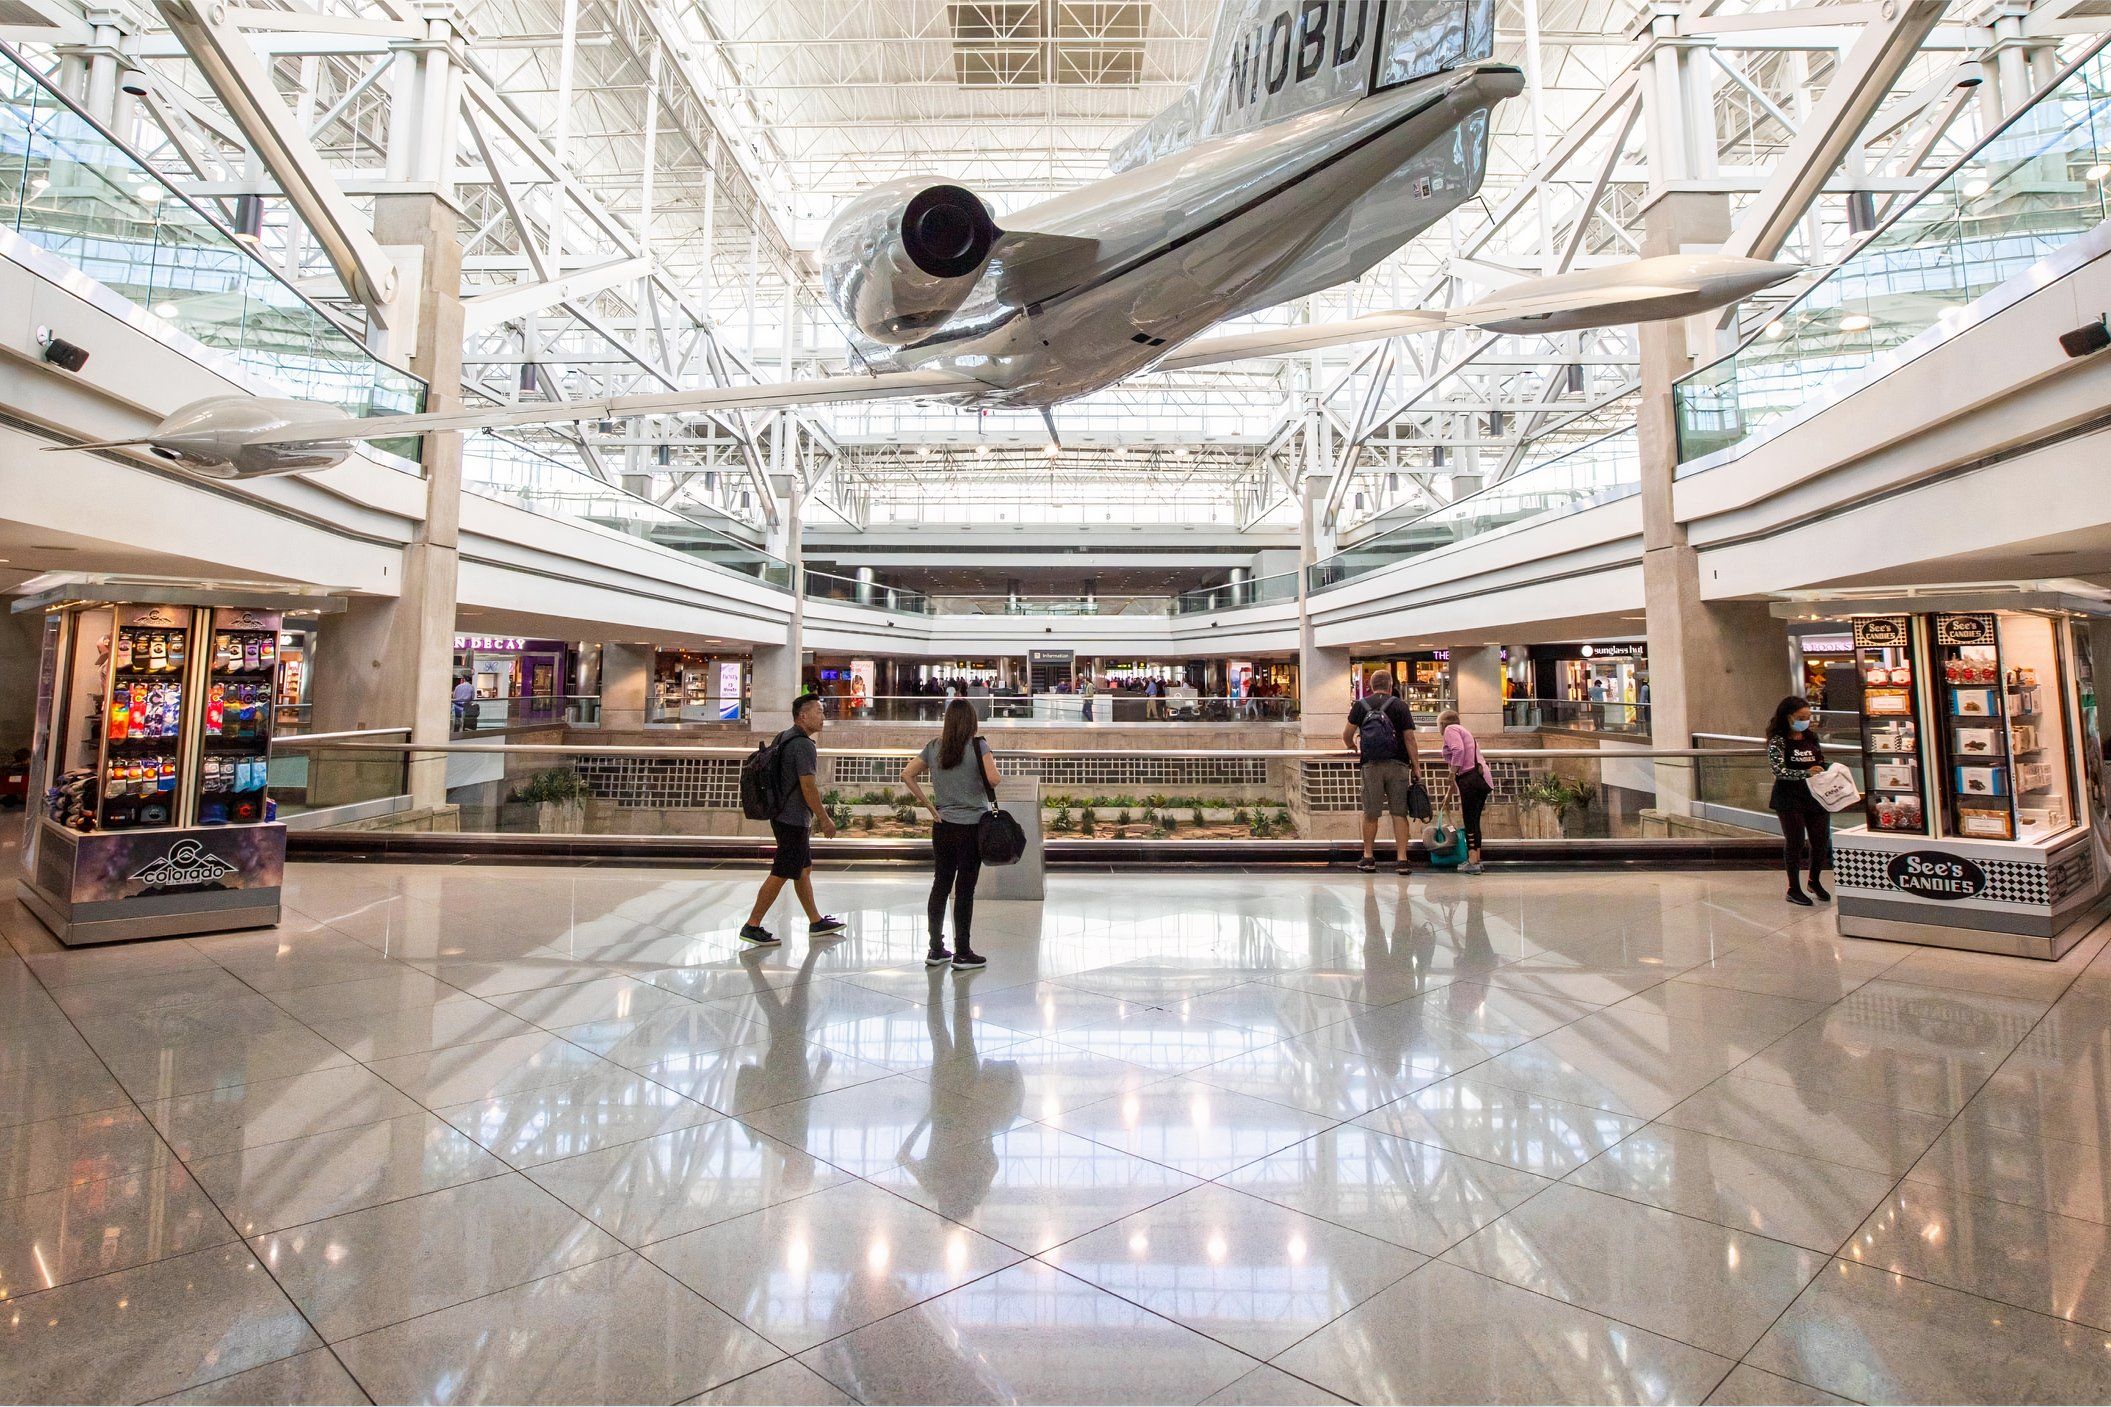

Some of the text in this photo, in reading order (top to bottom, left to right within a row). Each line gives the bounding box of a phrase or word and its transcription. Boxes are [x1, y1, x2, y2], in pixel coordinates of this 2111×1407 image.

[1869, 623, 1892, 632] See's
[1952, 620, 1977, 630] See's
[471, 637, 525, 649] DECAY
[1433, 651, 1449, 660] THE
[1594, 645, 1643, 656] sunglass hut
[1907, 856, 1963, 876] See's
[143, 865, 225, 883] colorado
[1899, 874, 1974, 894] CANDIES
